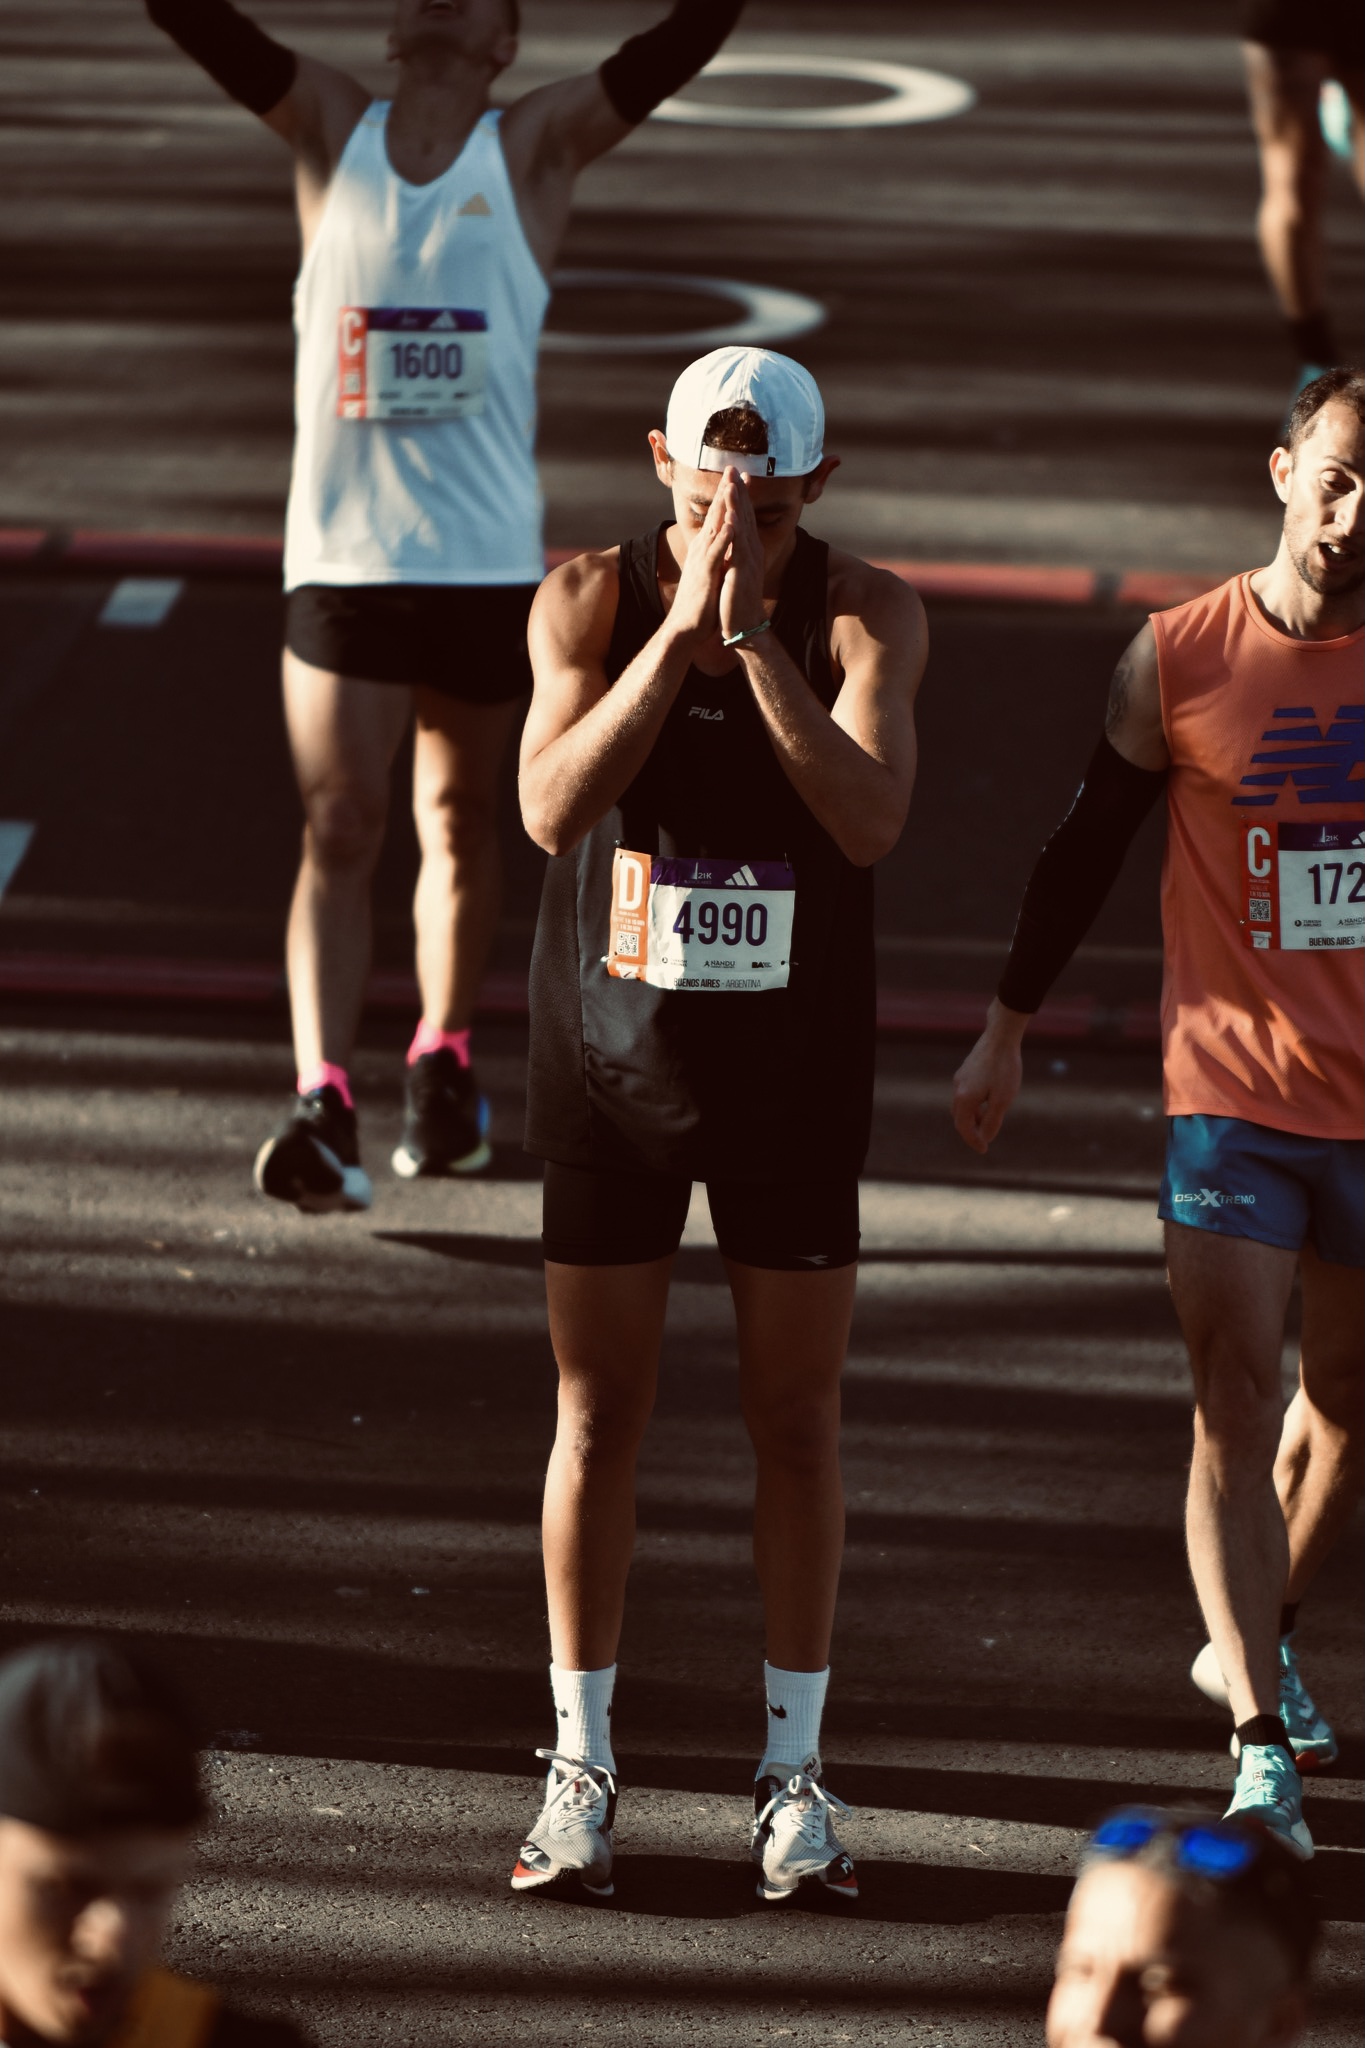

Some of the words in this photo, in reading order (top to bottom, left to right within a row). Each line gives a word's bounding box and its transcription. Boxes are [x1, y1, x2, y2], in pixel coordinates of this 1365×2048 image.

[343, 310, 362, 356] C
[390, 342, 463, 379] 1600
[688, 706, 725, 721] FILA
[1247, 826, 1271, 878] C
[618, 857, 643, 910] D
[672, 901, 768, 947] 4990
[1308, 937, 1336, 947] BUENOS
[1336, 935, 1356, 946] AIRES
[674, 978, 700, 988] BUENOS
[700, 978, 721, 988] AIRES
[725, 979, 762, 989] ARGENTINA
